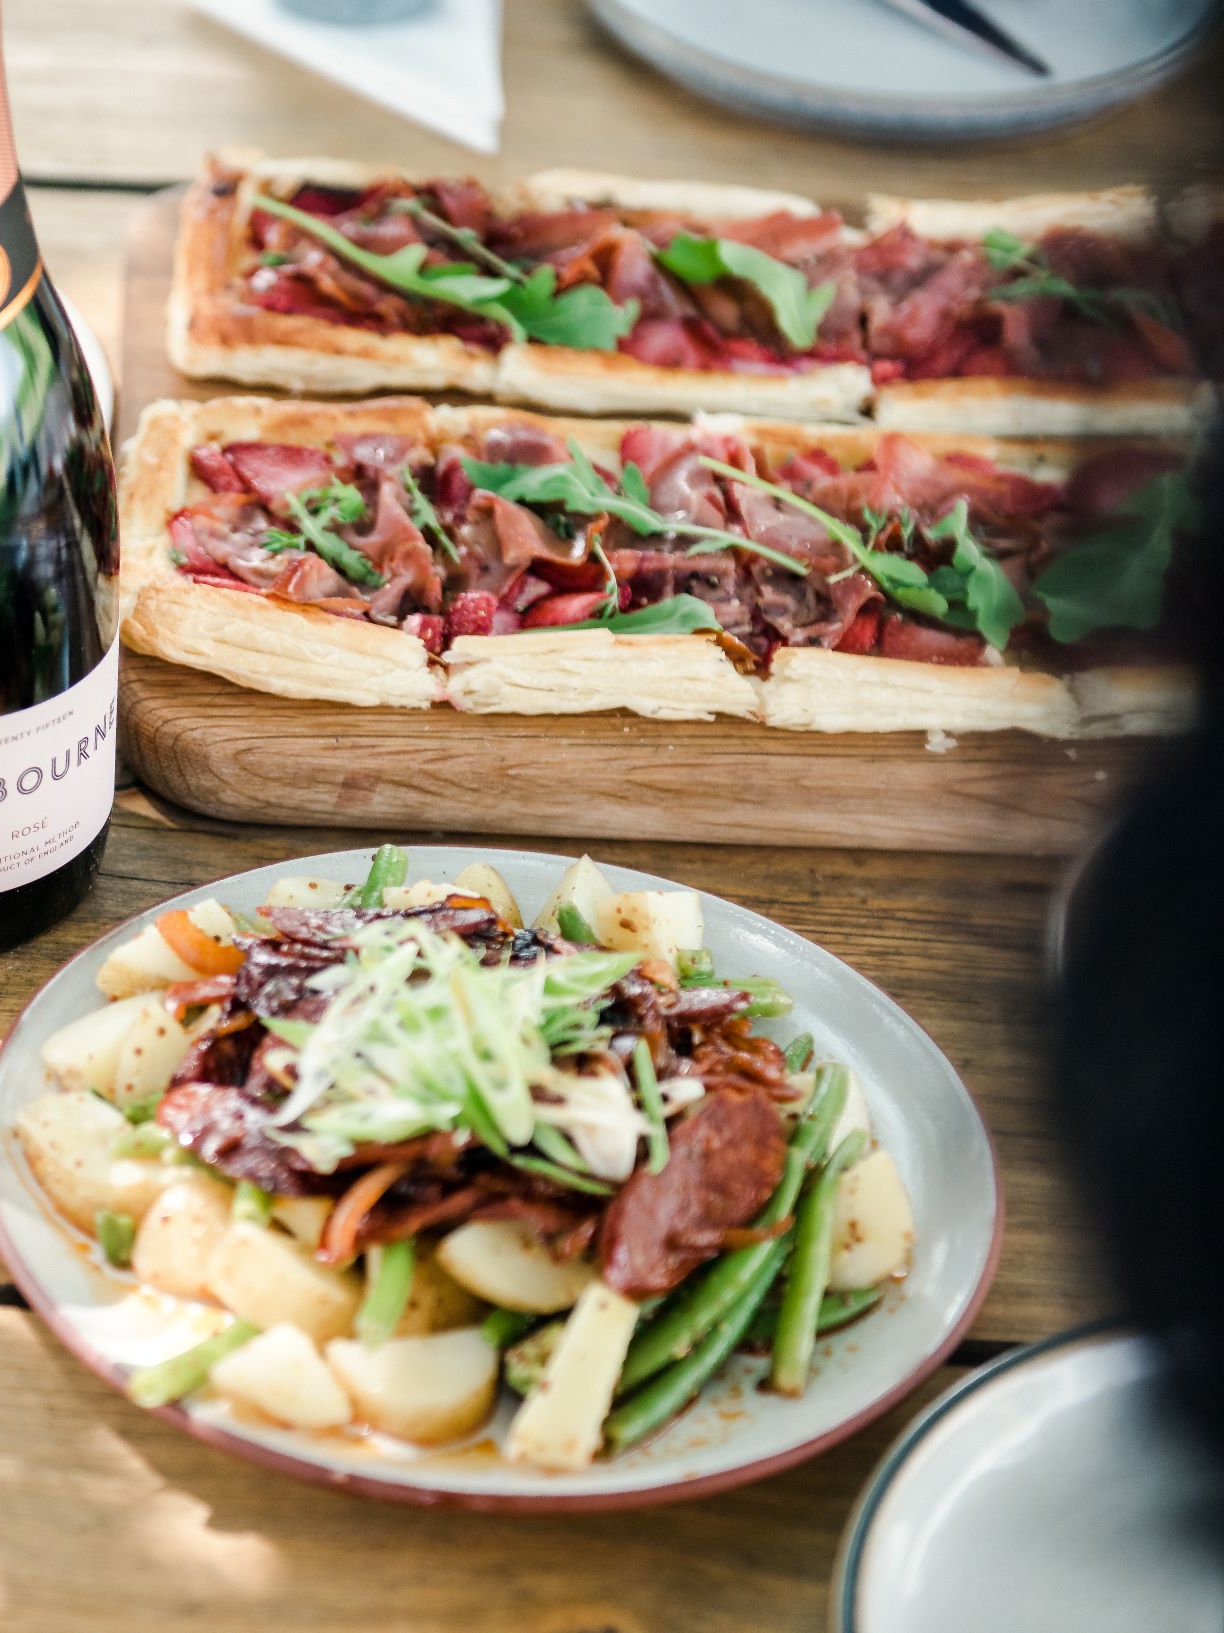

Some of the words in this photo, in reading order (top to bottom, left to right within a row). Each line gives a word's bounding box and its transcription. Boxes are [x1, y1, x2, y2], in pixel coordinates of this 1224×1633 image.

[35, 709, 75, 733] FIFTEEN
[11, 816, 49, 840] ROSÉ
[44, 821, 80, 847] METHOD
[24, 857, 36, 865] OF
[38, 836, 74, 860] ENGLAND
